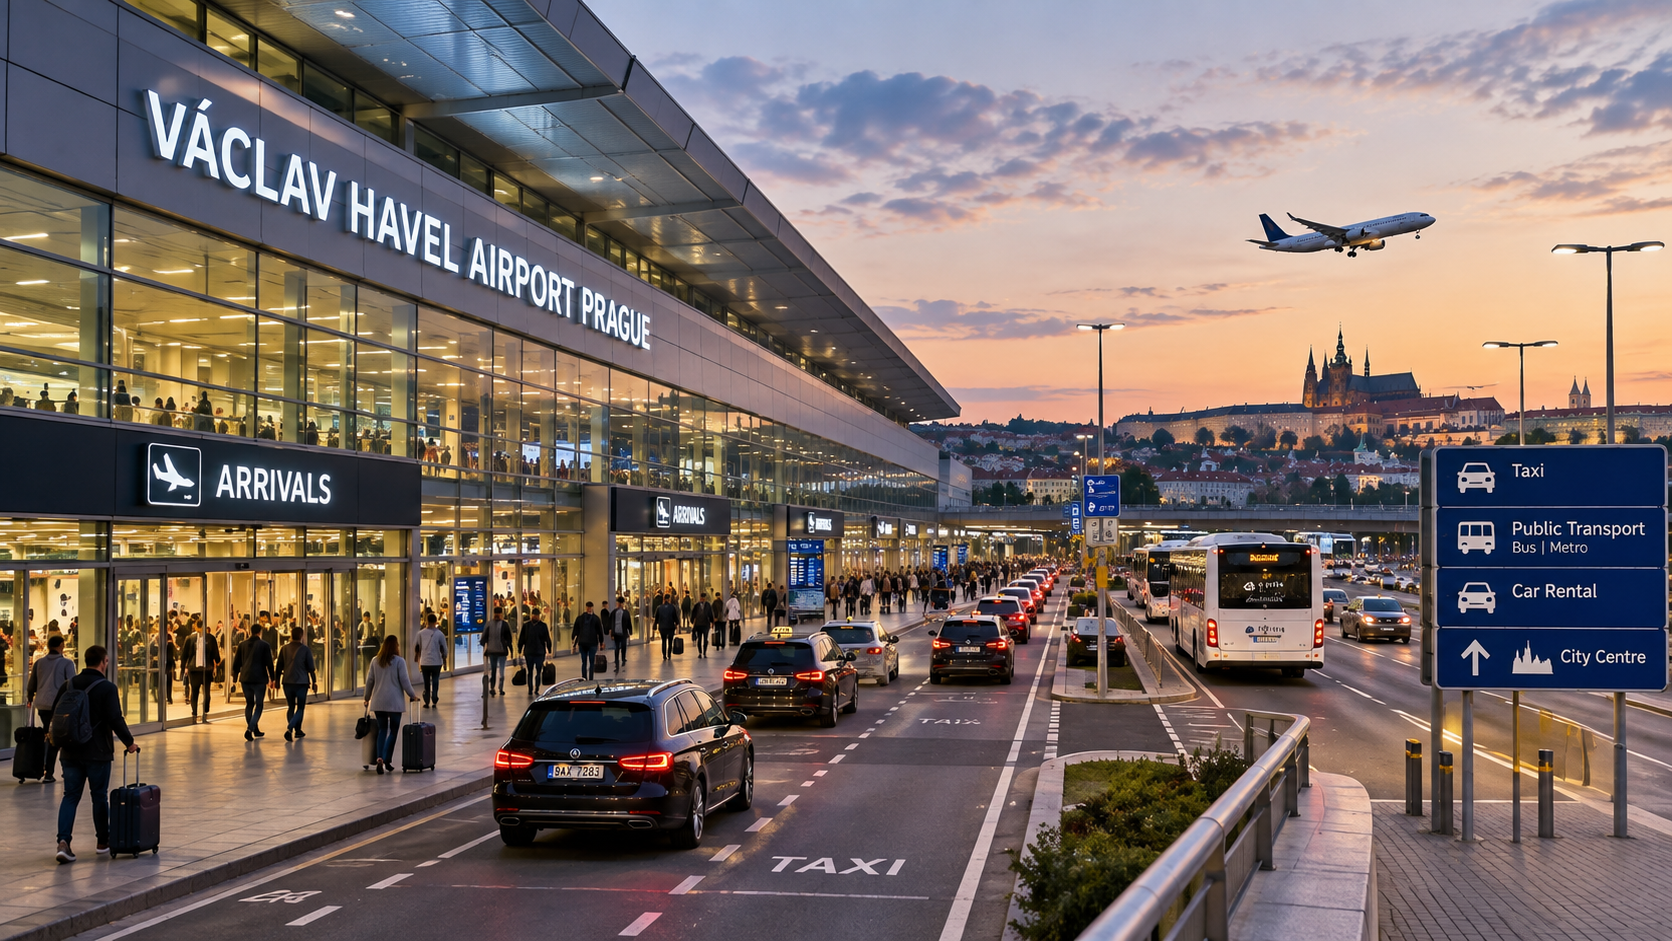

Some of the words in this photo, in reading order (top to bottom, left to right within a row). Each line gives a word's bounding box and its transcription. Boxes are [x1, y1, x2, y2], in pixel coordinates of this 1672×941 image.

[144, 89, 337, 221] VÁCLAV
[346, 180, 459, 274] HAVEL
[466, 237, 575, 318] AIRPORT
[579, 286, 651, 350] PRAGUE
[1511, 463, 1544, 478] Taxi
[215, 464, 332, 505] ARRIVALS
[1512, 520, 1562, 536] Public
[1566, 521, 1646, 540] Transport
[1512, 541, 1537, 554] Bus
[1550, 541, 1589, 554] Metro
[1512, 583, 1541, 598] Car
[1545, 582, 1598, 599] Rental
[1560, 648, 1592, 667] City
[1595, 649, 1647, 664] Centre
[577, 765, 600, 777] 7283
[771, 856, 906, 876] TAXI
